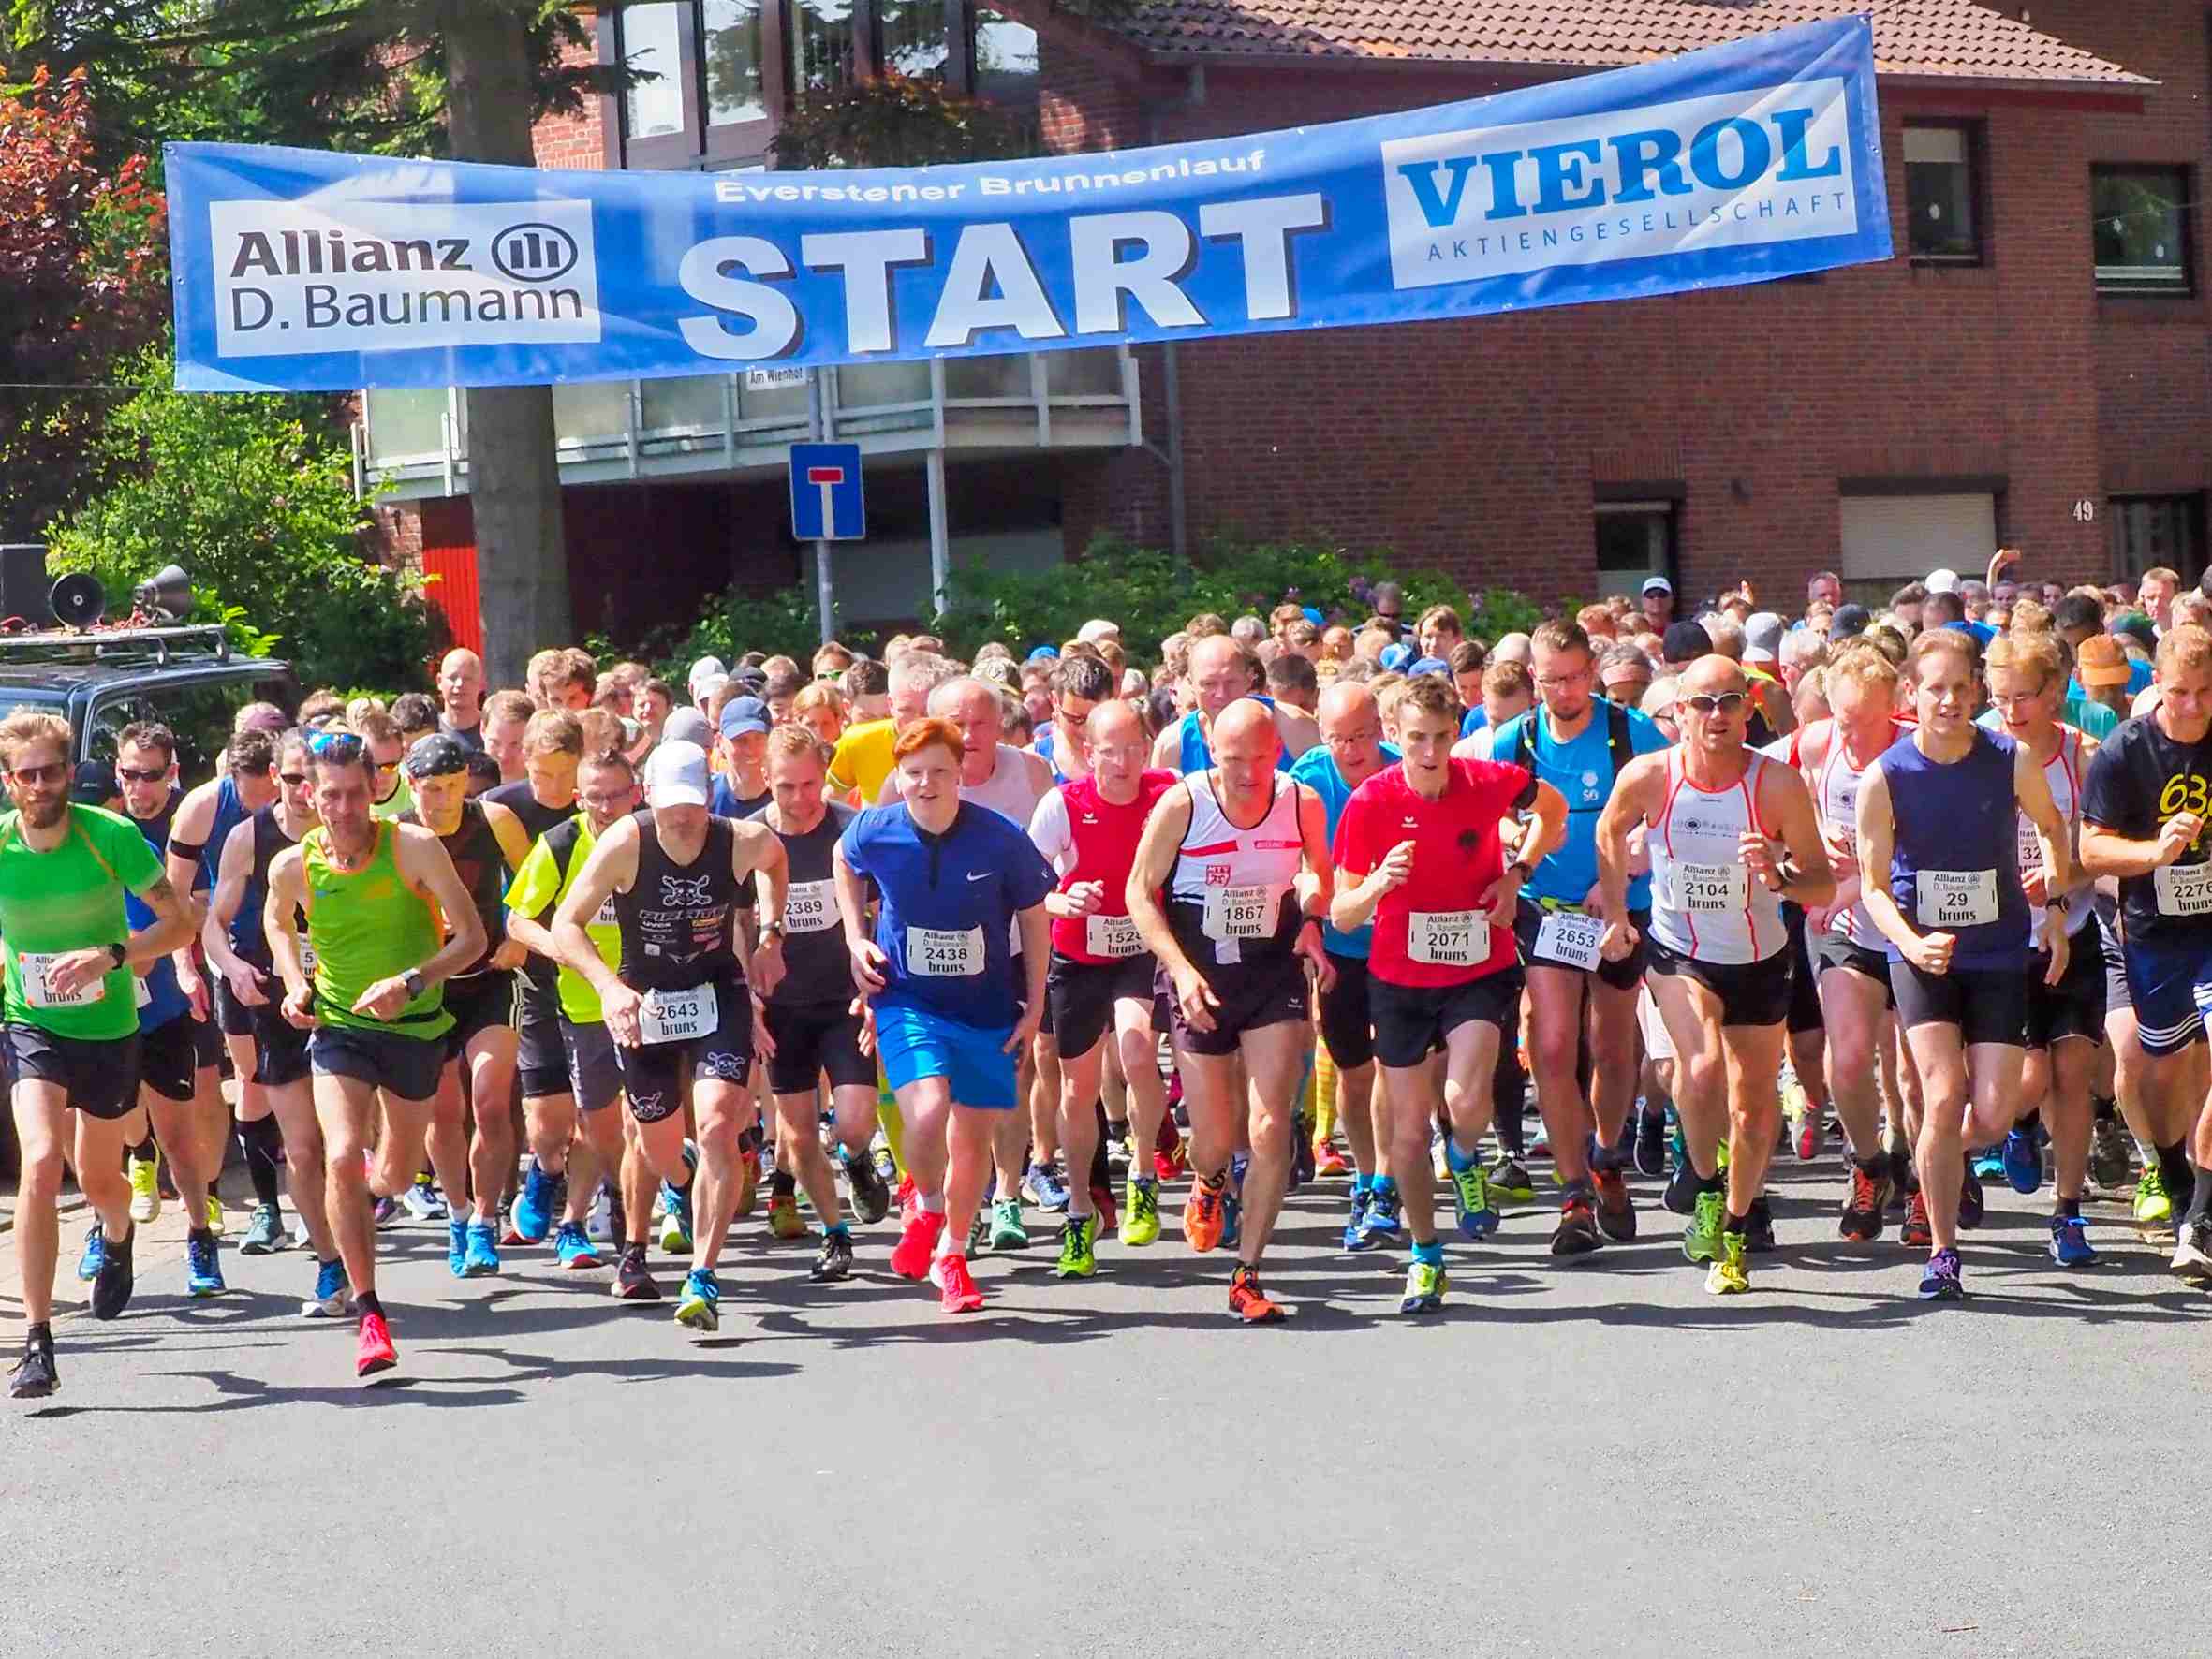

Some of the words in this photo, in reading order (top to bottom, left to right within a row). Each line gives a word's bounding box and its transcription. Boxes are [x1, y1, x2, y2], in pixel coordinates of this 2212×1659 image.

[1397, 108, 1842, 228] VIEROL
[715, 180, 966, 204] Everstener
[980, 150, 1266, 197] Brunnenlauf
[1426, 191, 1846, 263] AKTIENGESELLSCHAFT
[230, 228, 472, 278] Allianz
[677, 192, 1331, 360] START
[231, 286, 291, 331] D.
[305, 283, 582, 330] Baumann
[2072, 500, 2094, 521] 49
[1684, 864, 1716, 874] Allianz
[2170, 868, 2201, 877] Allianz
[1934, 874, 1966, 883] Allianz
[1223, 889, 1254, 898] Allianz
[1685, 882, 1729, 896] 2104
[1688, 896, 1726, 909] bruns
[1947, 892, 1968, 906] 29
[786, 901, 823, 915] 2389
[1224, 905, 1264, 920] 1867
[1939, 907, 1976, 921] bruns
[789, 916, 823, 929] bruns
[1427, 914, 1458, 923] Allianz
[1225, 921, 1261, 935] bruns
[923, 931, 955, 941] Allianz
[1428, 932, 1468, 946] 2071
[1556, 928, 1596, 948] 2653
[925, 947, 967, 961] 2438
[1431, 947, 1467, 962] bruns
[1556, 942, 1590, 962] bruns
[929, 961, 966, 973] bruns
[44, 989, 82, 1003] bruns
[656, 1002, 699, 1020] 2643
[661, 1020, 698, 1035] bruns
